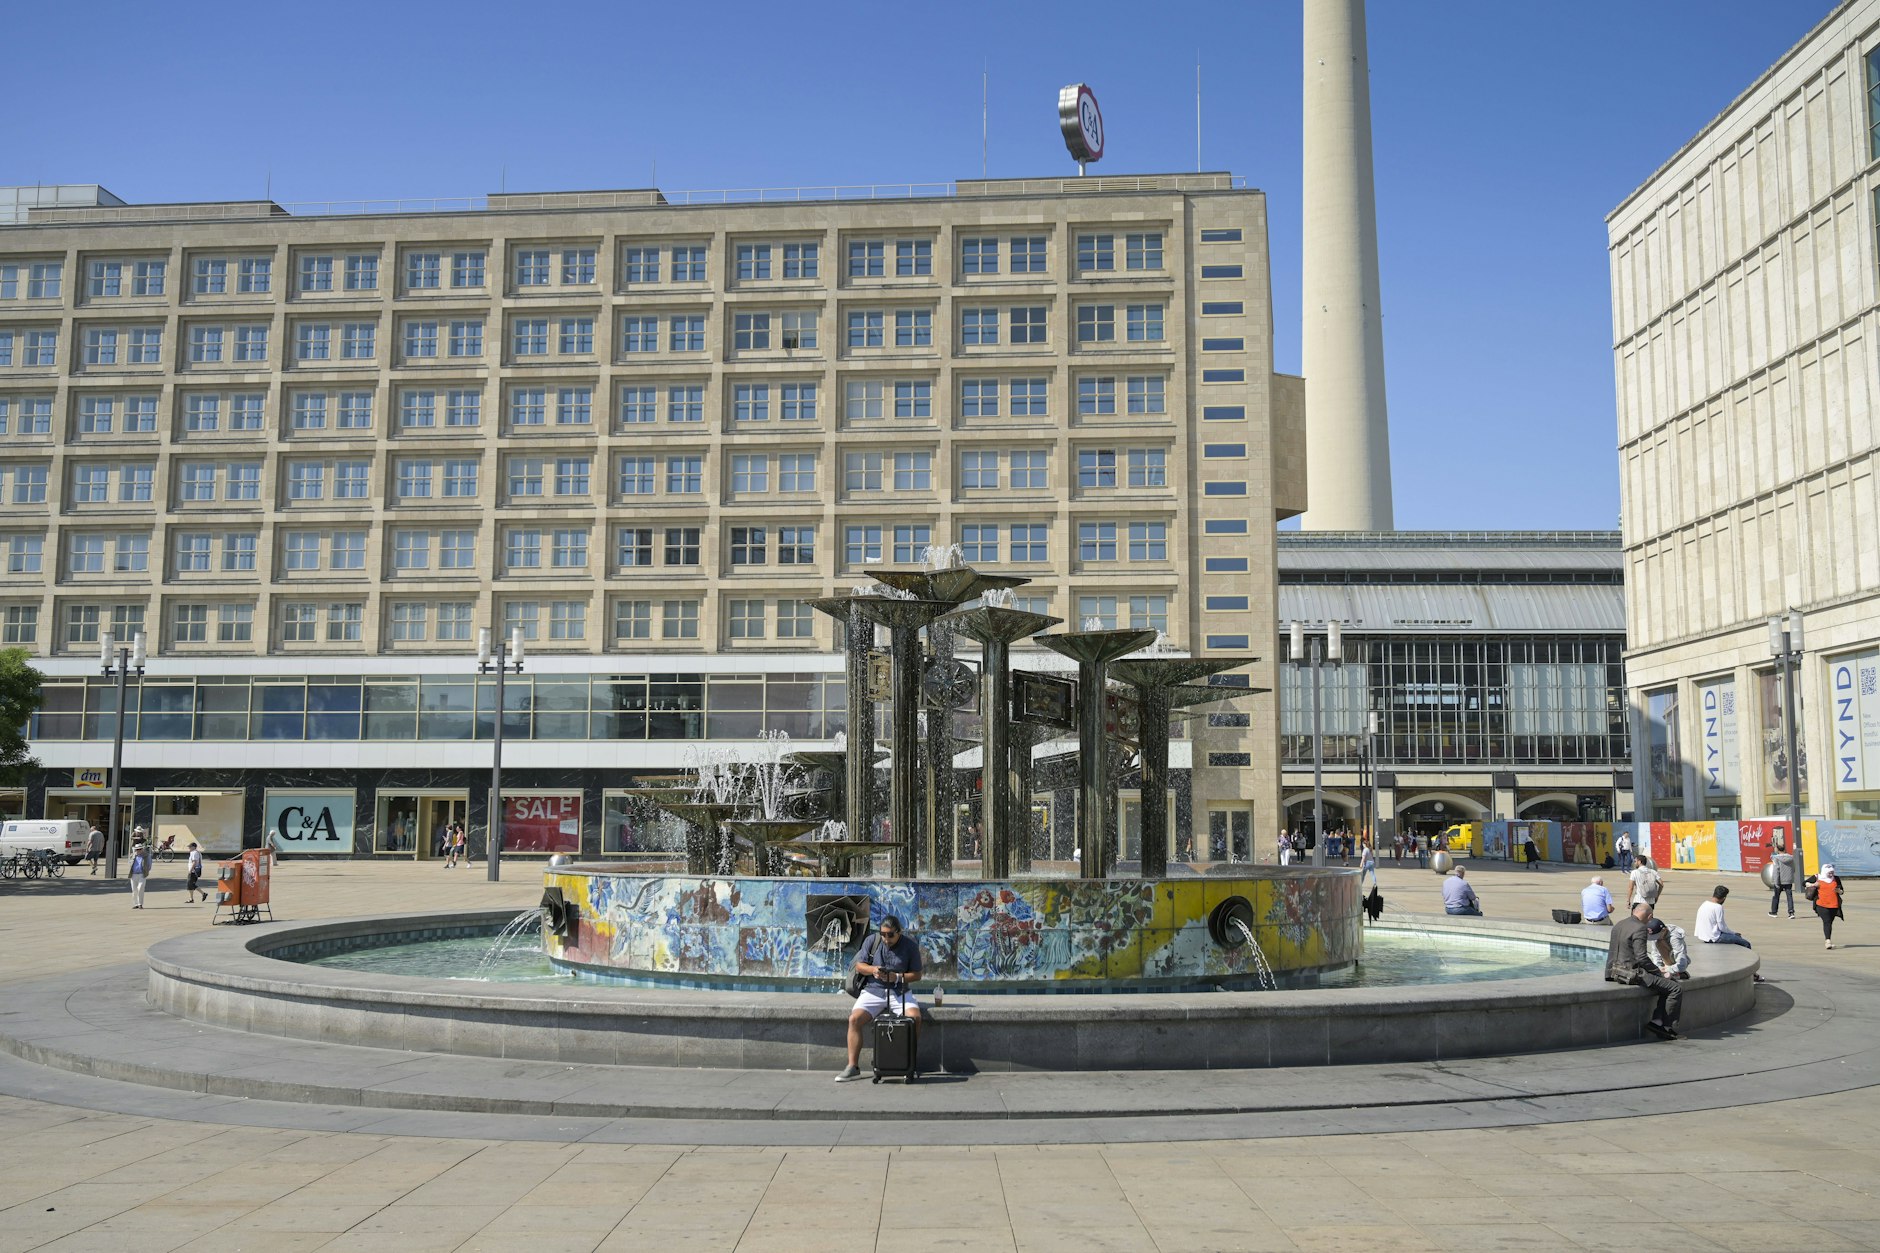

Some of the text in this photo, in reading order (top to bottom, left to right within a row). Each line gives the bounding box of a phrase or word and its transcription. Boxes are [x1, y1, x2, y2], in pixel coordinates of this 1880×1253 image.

[1082, 101, 1099, 146] C&A
[1705, 690, 1720, 789] MYND
[1836, 666, 1857, 783] MYND
[80, 769, 101, 781] dm
[278, 806, 340, 841] C&A
[515, 798, 573, 820] SALE
